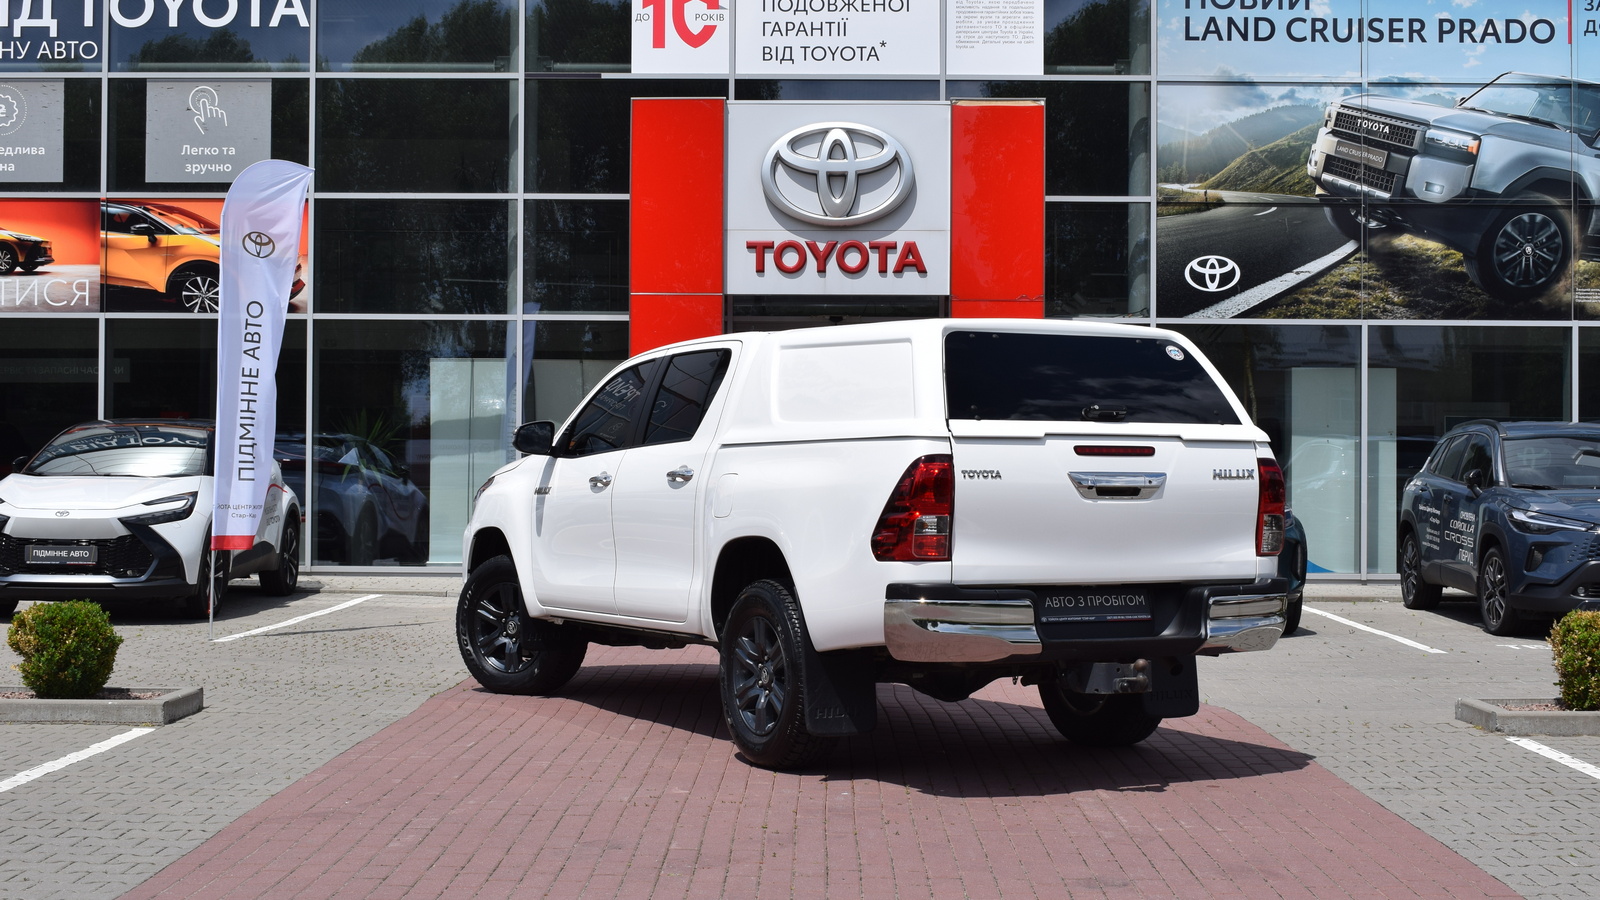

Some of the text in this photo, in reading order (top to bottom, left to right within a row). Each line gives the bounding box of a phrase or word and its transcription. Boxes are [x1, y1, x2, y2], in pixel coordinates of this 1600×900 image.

[635, 13, 650, 23] ДО
[694, 13, 725, 22] РОКІВ
[762, 17, 848, 37] ГАРАНТІЇ
[1184, 16, 1556, 44] LAND CRUISER PRADO
[1584, 20, 1600, 37] Д
[37, 40, 99, 59] АВТО
[762, 46, 794, 64] ВІД
[1357, 119, 1390, 134] TOYOTA
[181, 145, 236, 156] Легко та
[1336, 145, 1349, 153] LAND
[1368, 153, 1384, 163] PRADO
[185, 163, 232, 173] зручно
[745, 240, 928, 275] TOYOTA
[238, 300, 264, 482] ПІДМІННЕ АВТО
[961, 469, 1002, 480] TOYOTA
[1212, 468, 1255, 481] HILUX
[1449, 519, 1475, 533] COROLLA
[1444, 530, 1473, 547] CROSS
[33, 549, 68, 557] ПІДМІННЕ
[1045, 597, 1075, 608] АВТО
[1087, 595, 1146, 607] ПРОБІГОМ
